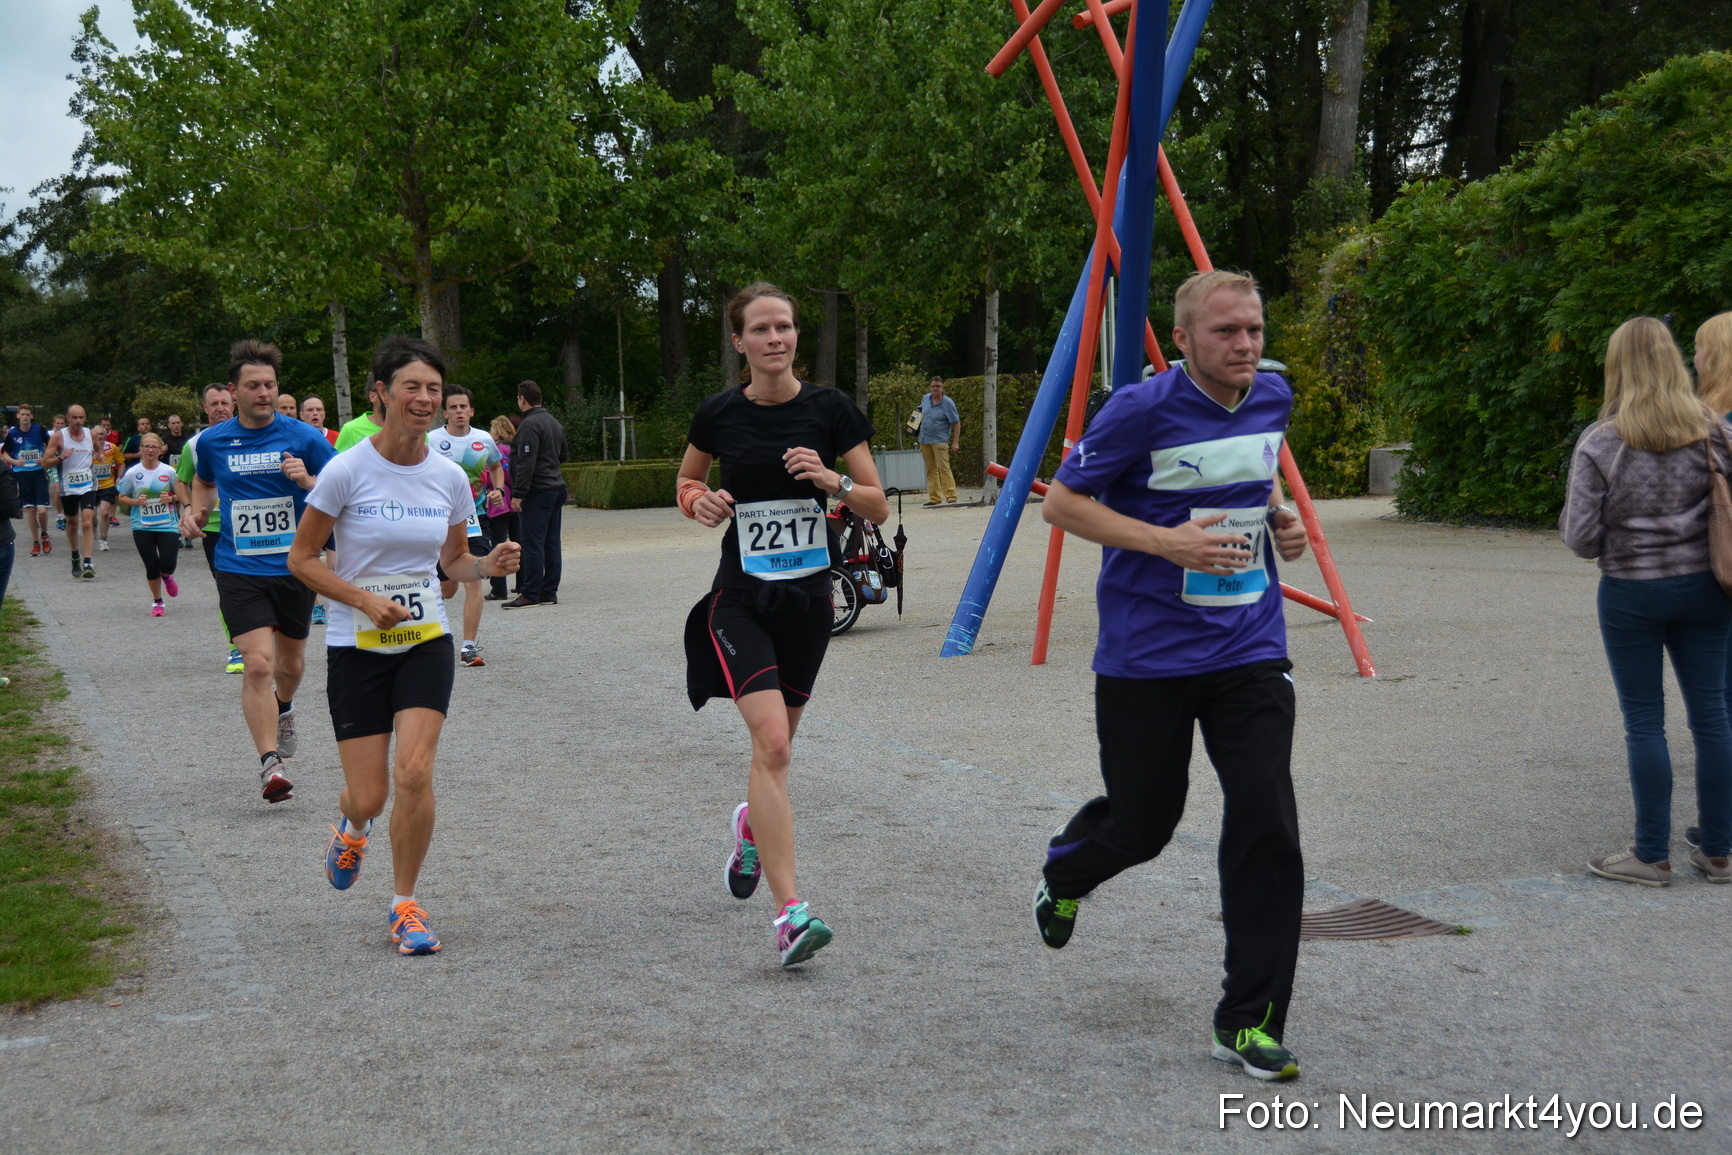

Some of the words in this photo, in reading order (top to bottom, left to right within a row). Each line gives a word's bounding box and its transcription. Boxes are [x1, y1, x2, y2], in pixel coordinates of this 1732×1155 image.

[228, 451, 281, 466] HUBER
[69, 473, 90, 483] 2411
[143, 503, 168, 515] 3102
[358, 506, 377, 516] FeG
[738, 511, 767, 519] PARTL
[769, 506, 811, 516] Neumarkt
[238, 510, 290, 534] 2193
[748, 517, 818, 552] 2217
[250, 537, 281, 547] Herbert
[770, 555, 803, 569] Maria
[384, 581, 421, 591] Neumarkt
[1217, 578, 1244, 592] Peter
[380, 630, 422, 645] Brigitte
